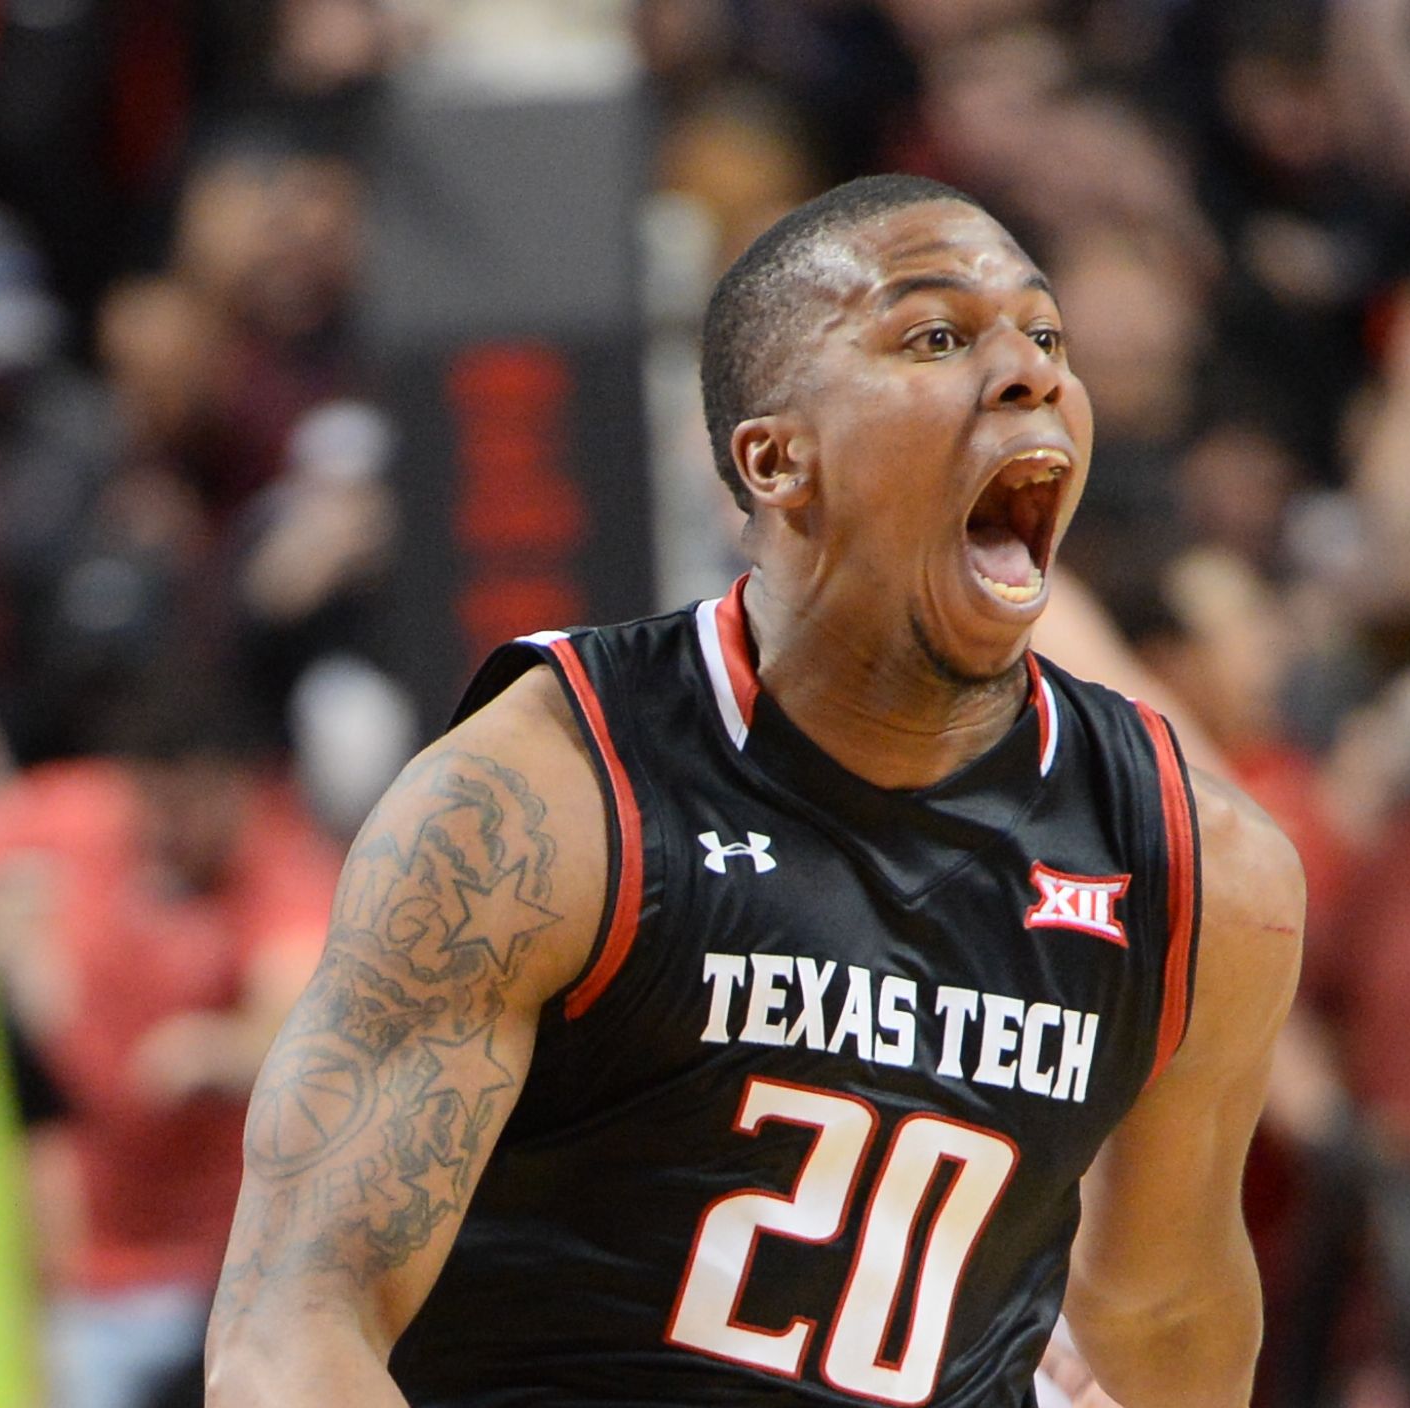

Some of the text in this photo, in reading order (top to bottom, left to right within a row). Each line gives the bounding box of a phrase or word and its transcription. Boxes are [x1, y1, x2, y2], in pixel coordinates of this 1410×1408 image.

[1029, 867, 1125, 938] XII
[700, 952, 1100, 1104] TEXAS TECH
[664, 1073, 1021, 1408] 20
